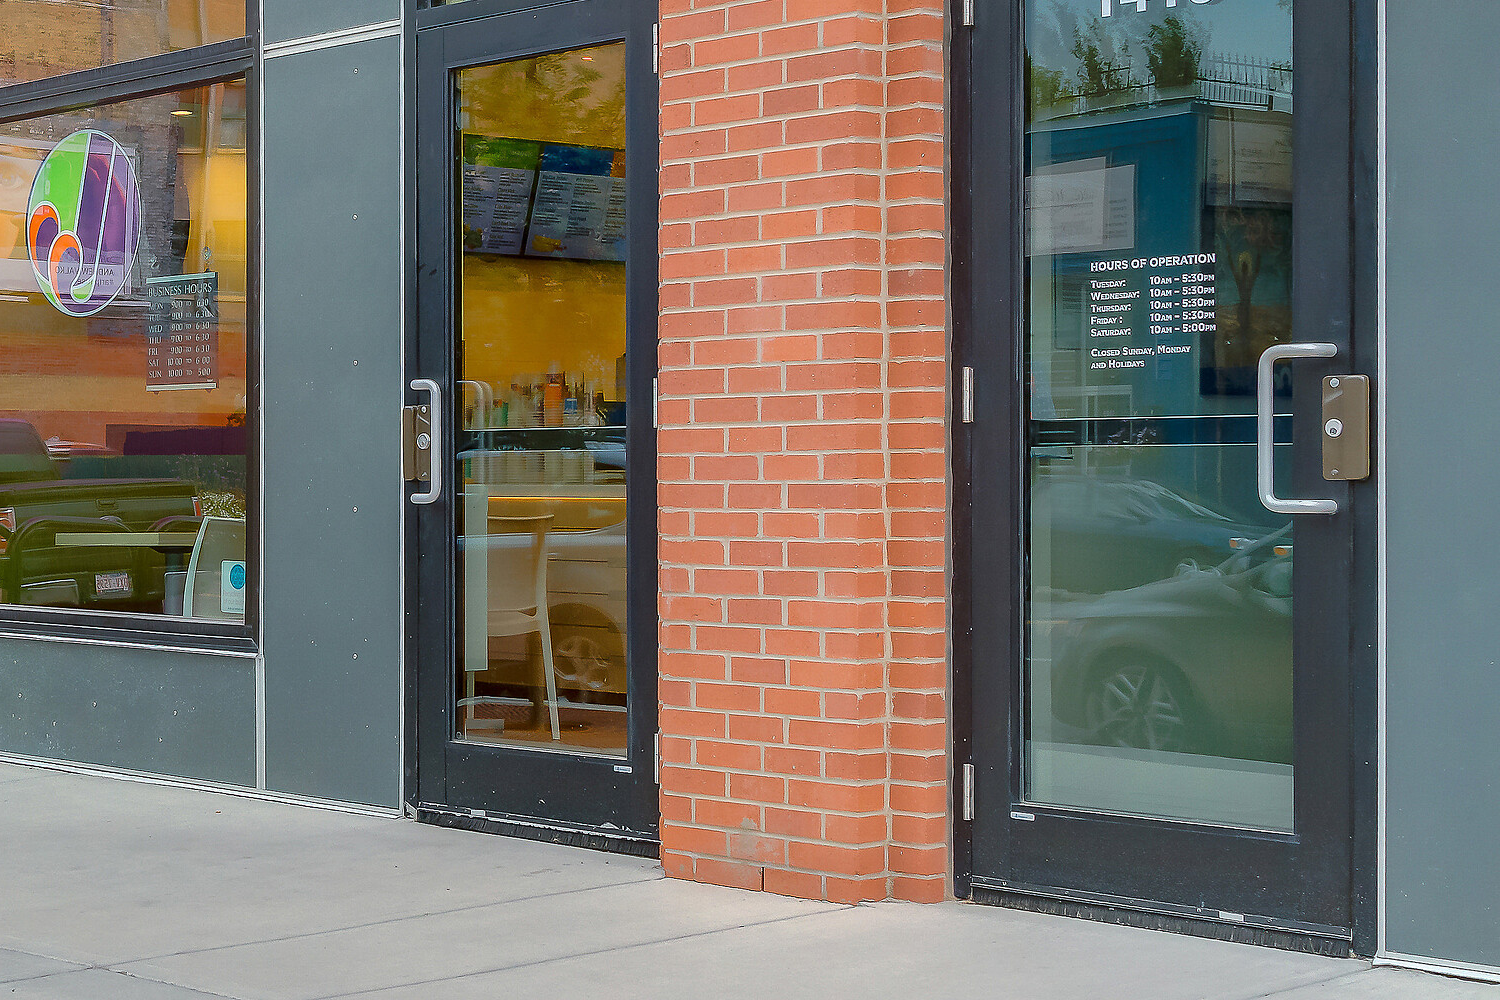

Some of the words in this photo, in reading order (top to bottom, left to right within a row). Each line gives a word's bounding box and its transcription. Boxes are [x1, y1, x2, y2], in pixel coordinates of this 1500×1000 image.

[1090, 260, 1129, 273] HOURS
[1130, 259, 1147, 269] OF
[1149, 253, 1216, 267] OPERATION
[148, 285, 182, 297] BUSINESS
[184, 282, 213, 294] HOURS
